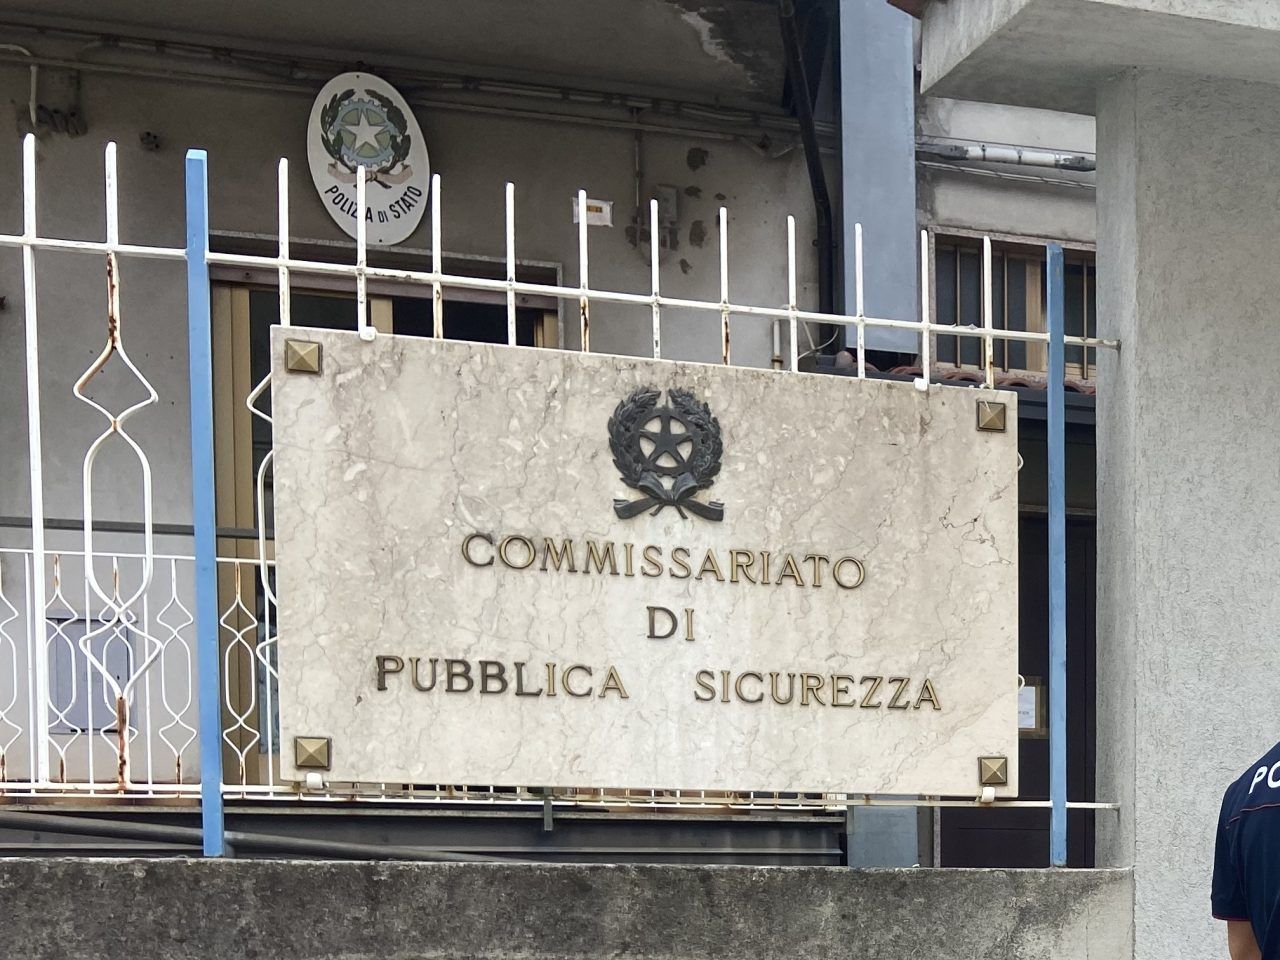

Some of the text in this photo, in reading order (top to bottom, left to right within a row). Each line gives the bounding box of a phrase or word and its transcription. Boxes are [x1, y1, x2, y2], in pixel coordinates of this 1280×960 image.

[324, 184, 423, 223] POLIZA DI STATO
[461, 532, 866, 590] COMMISSARIATO
[646, 605, 696, 642] DI
[375, 654, 943, 711] PUBBLICA SICUREZZA
